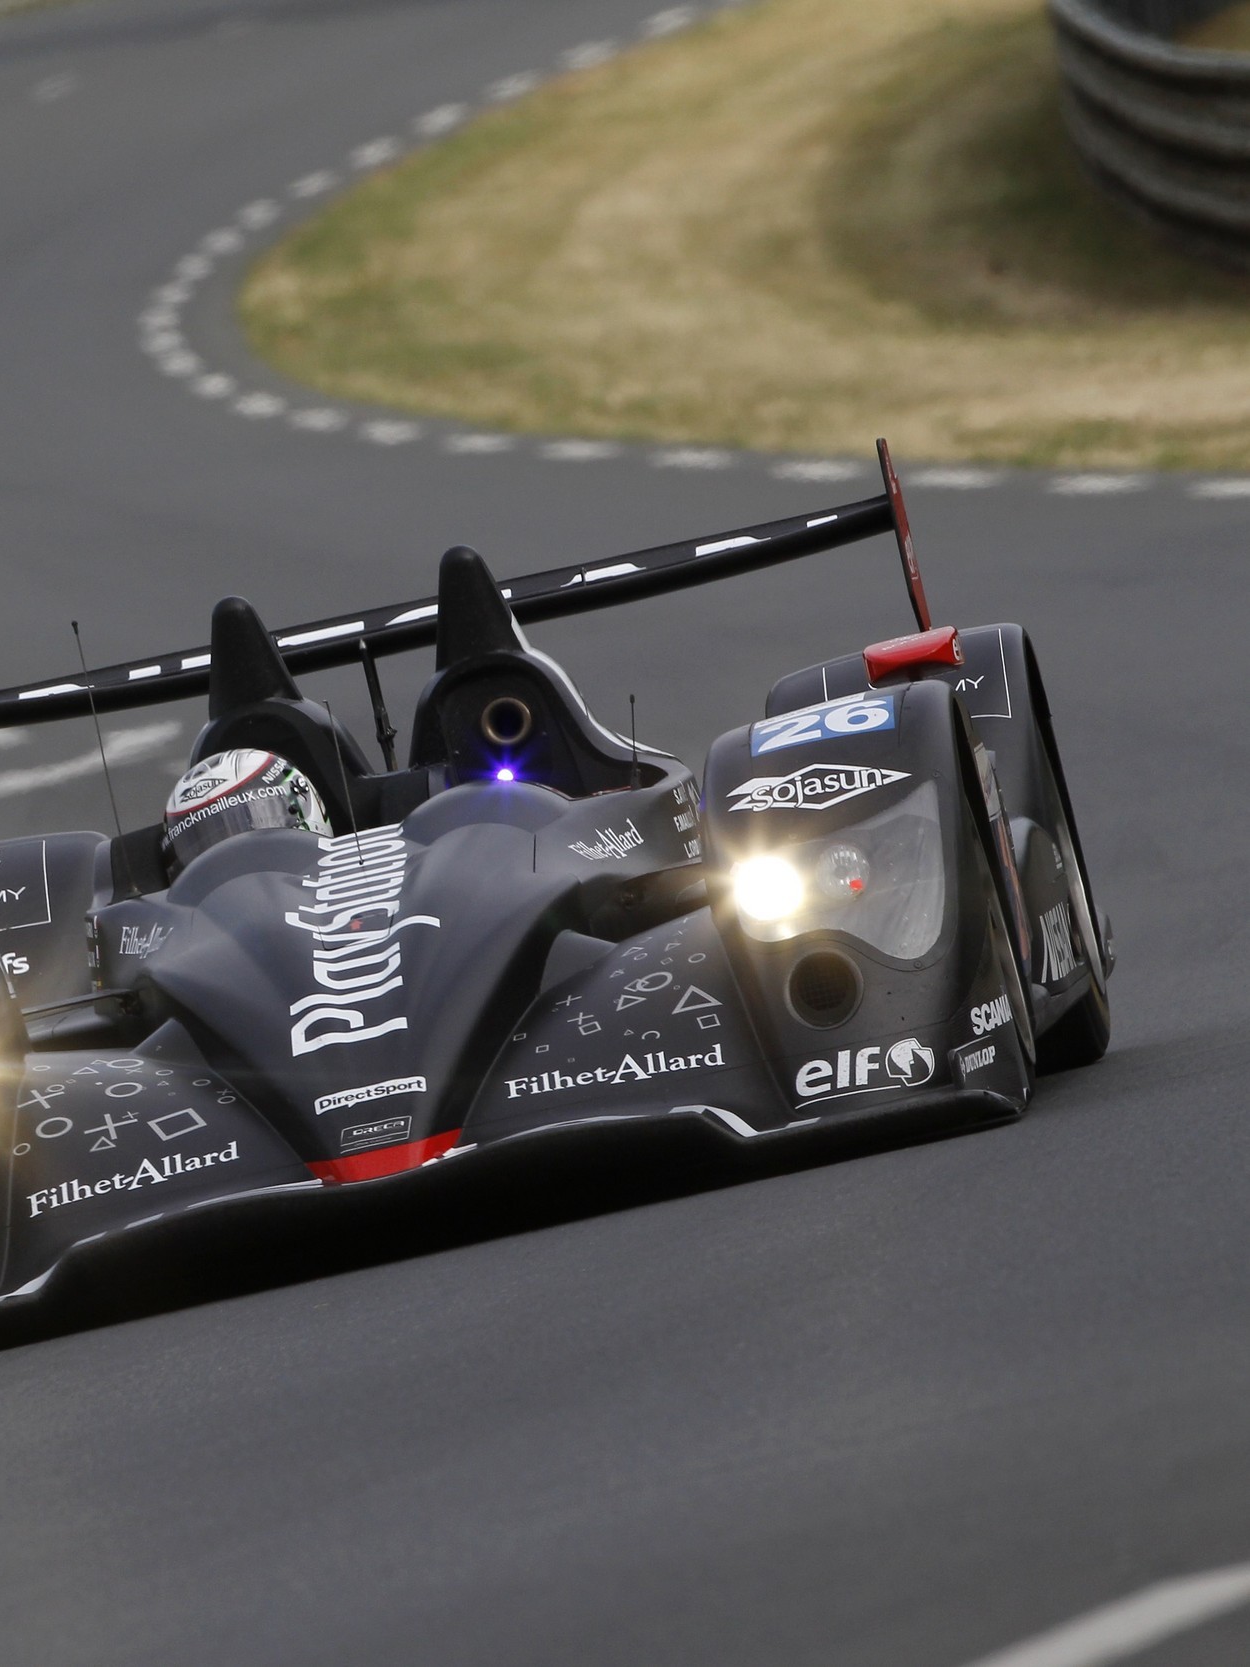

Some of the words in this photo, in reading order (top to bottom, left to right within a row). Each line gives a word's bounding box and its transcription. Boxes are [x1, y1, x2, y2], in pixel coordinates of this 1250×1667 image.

[758, 700, 890, 753] 26
[751, 765, 883, 812] sojasun
[285, 822, 441, 1057] PlayStation
[503, 1044, 726, 1099] Filhet-Allard
[796, 1046, 885, 1097] elf
[26, 1141, 240, 1218] Filhet-Allard
